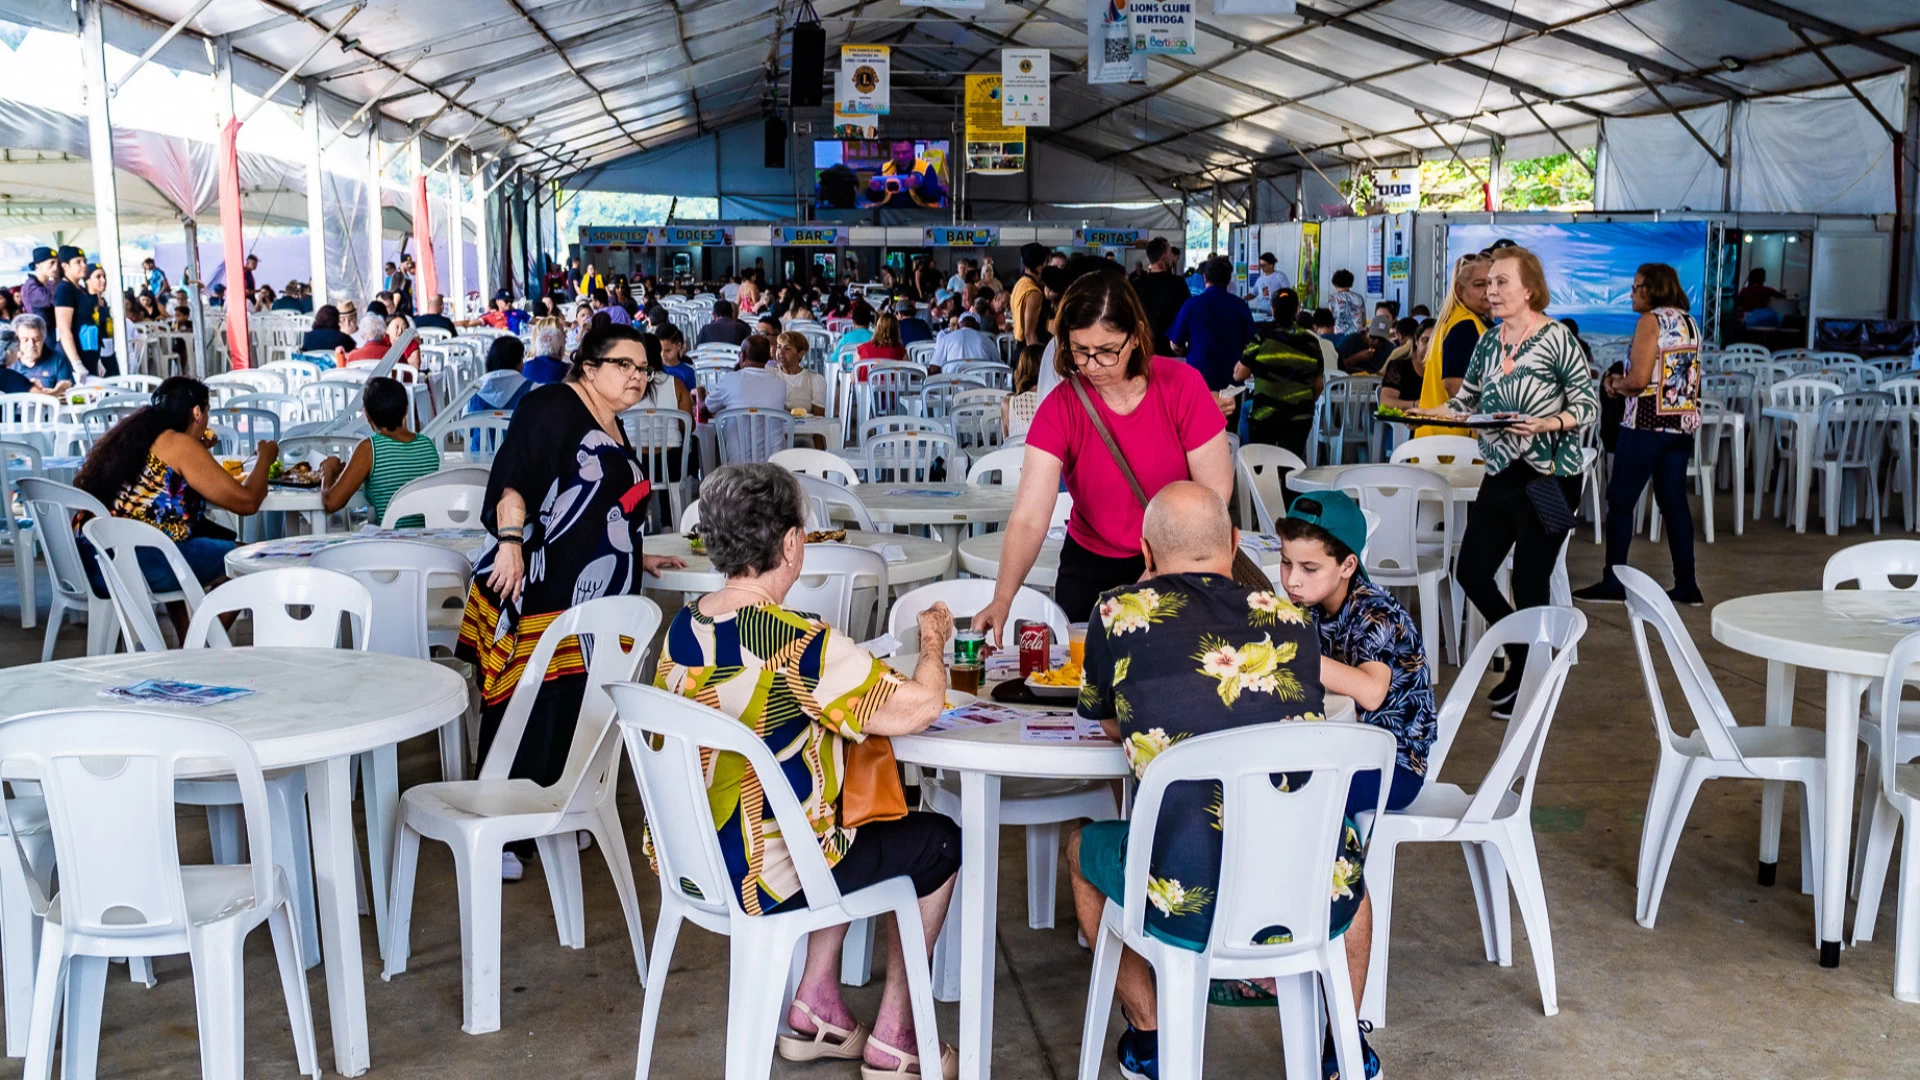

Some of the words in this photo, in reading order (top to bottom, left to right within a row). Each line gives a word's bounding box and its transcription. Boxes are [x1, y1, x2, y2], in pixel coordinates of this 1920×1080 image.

[1130, 3, 1159, 13] LIONS
[1162, 3, 1191, 13] CLUBE
[1136, 15, 1185, 24] BERTIOGA
[593, 230, 644, 241] SORVETES
[676, 229, 716, 241] DOCES
[795, 230, 822, 241] BAR
[946, 230, 974, 242] BAR
[1091, 232, 1132, 244] FRITAS
